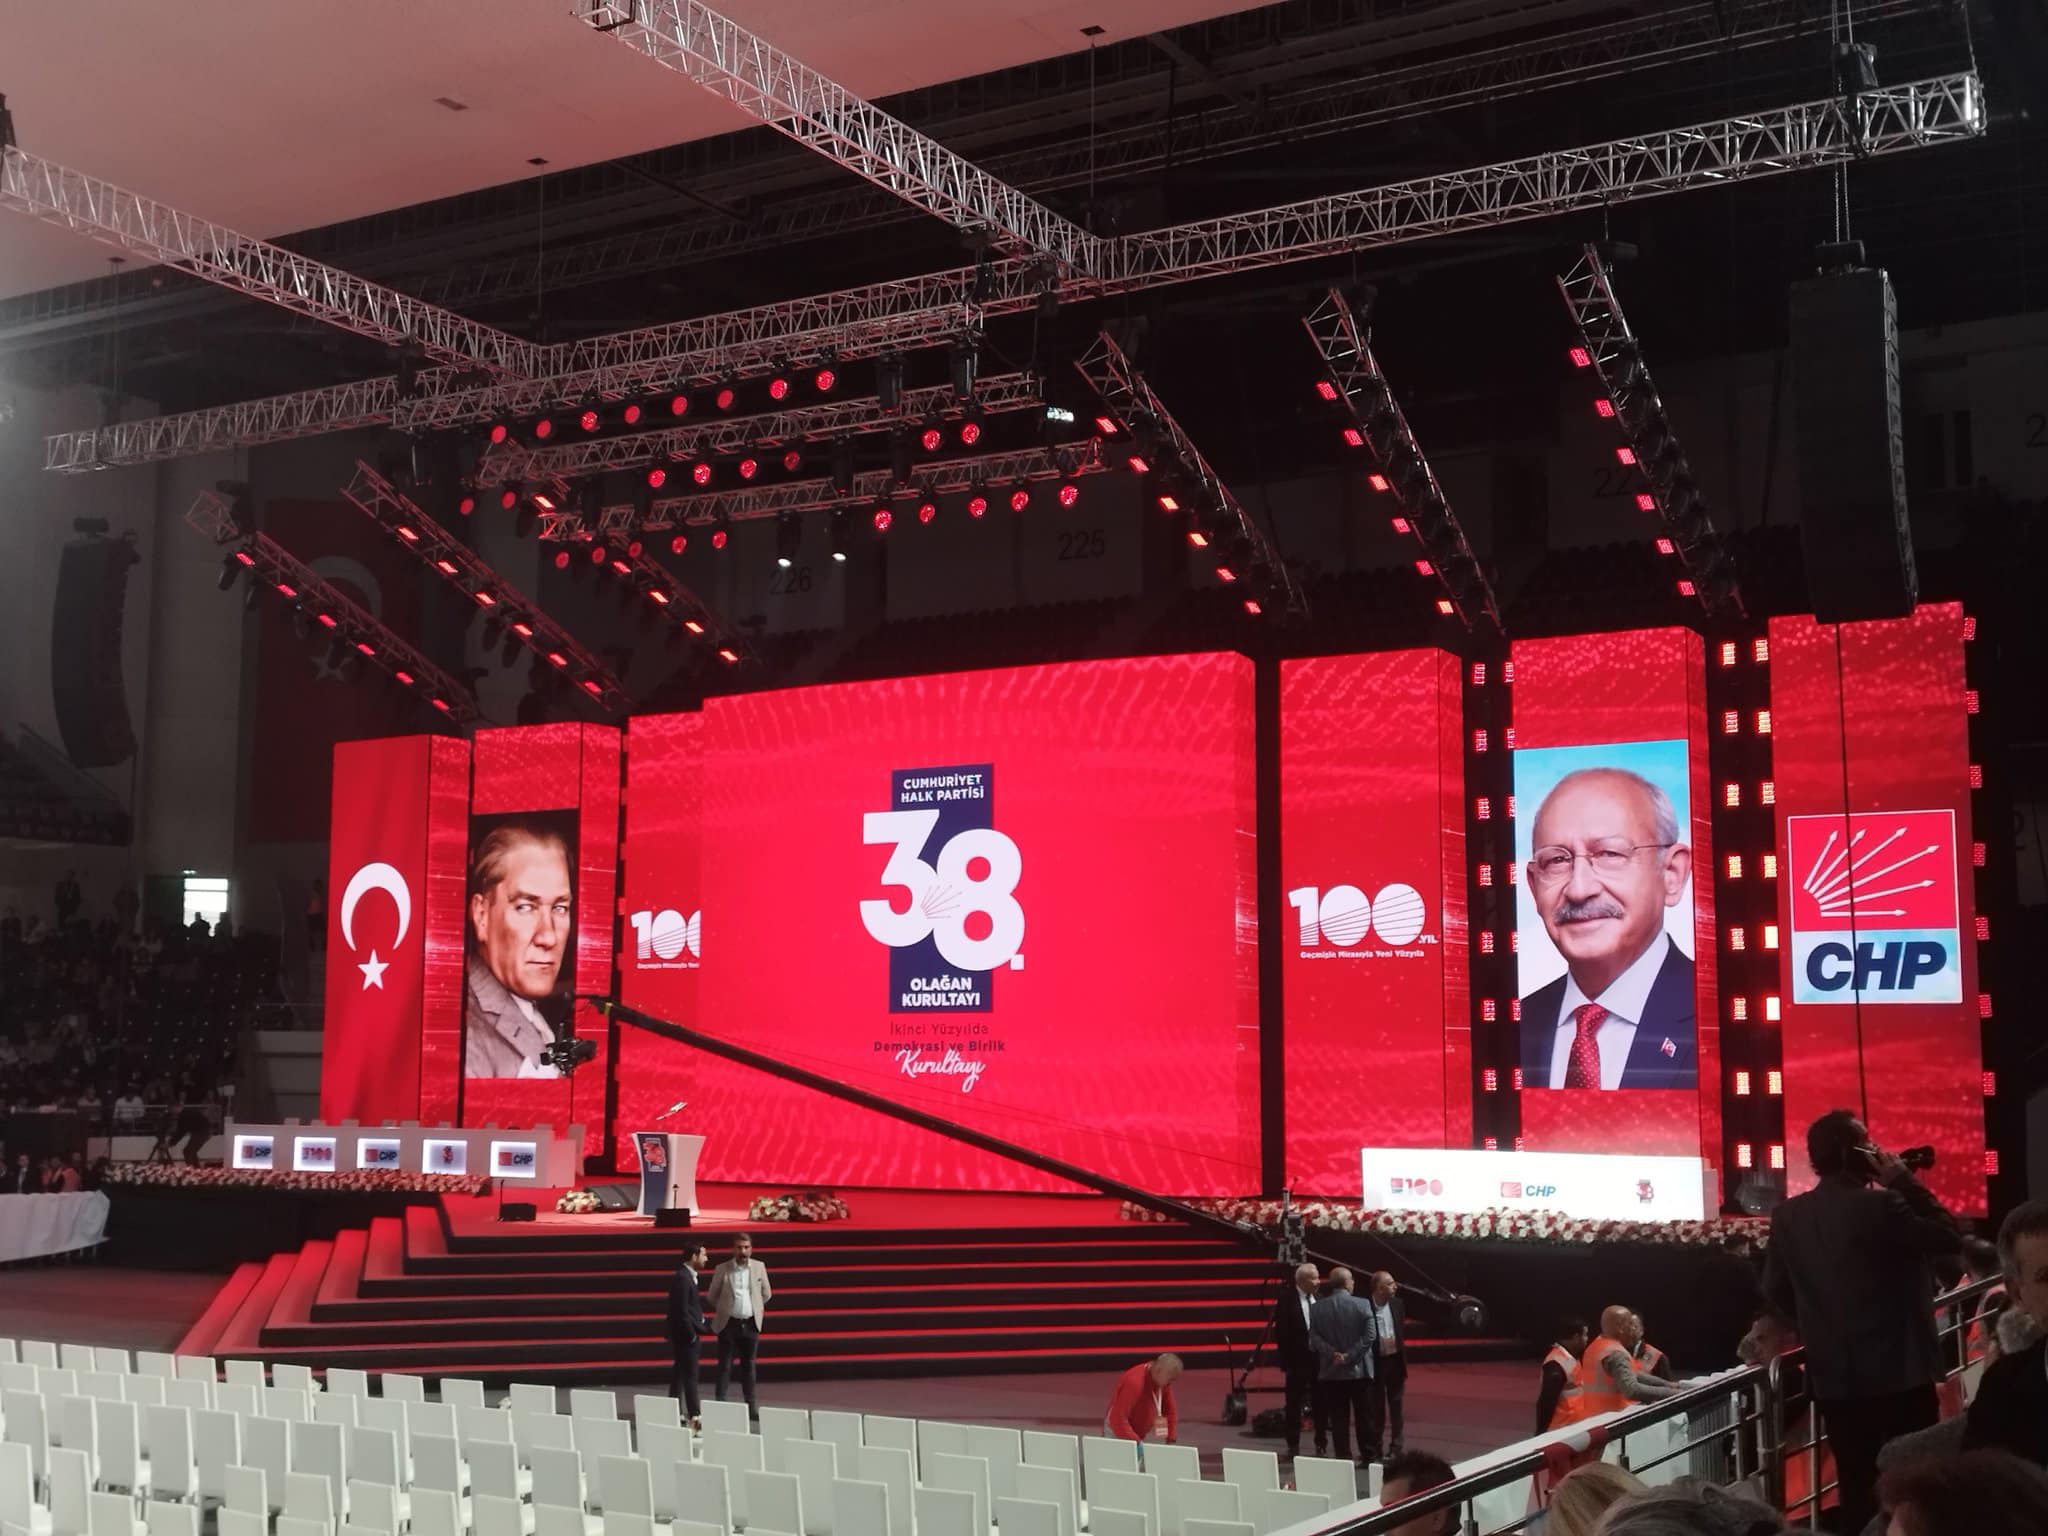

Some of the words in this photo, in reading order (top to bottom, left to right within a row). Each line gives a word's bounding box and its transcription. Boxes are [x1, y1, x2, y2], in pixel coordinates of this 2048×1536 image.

[1058, 529, 1104, 561] 225
[769, 567, 812, 595] 226
[903, 773, 982, 790] CUMHURİYET
[901, 790, 934, 803] HALK
[936, 785, 984, 800] PARTİSİ
[1288, 883, 1426, 947] 100
[1375, 950, 1393, 958] Yeni
[1806, 941, 1947, 991] CHP
[910, 974, 973, 991] OLAĞAN
[901, 992, 981, 1007] KURULTAYI
[890, 1020, 926, 1036] İkinci
[931, 1023, 989, 1038] Yüzyılda
[873, 1040, 944, 1052] Demokrasi
[949, 1042, 964, 1052] ve
[968, 1039, 1006, 1051] Birlik
[513, 1154, 534, 1165] CHP
[1525, 1185, 1557, 1197] CHP
